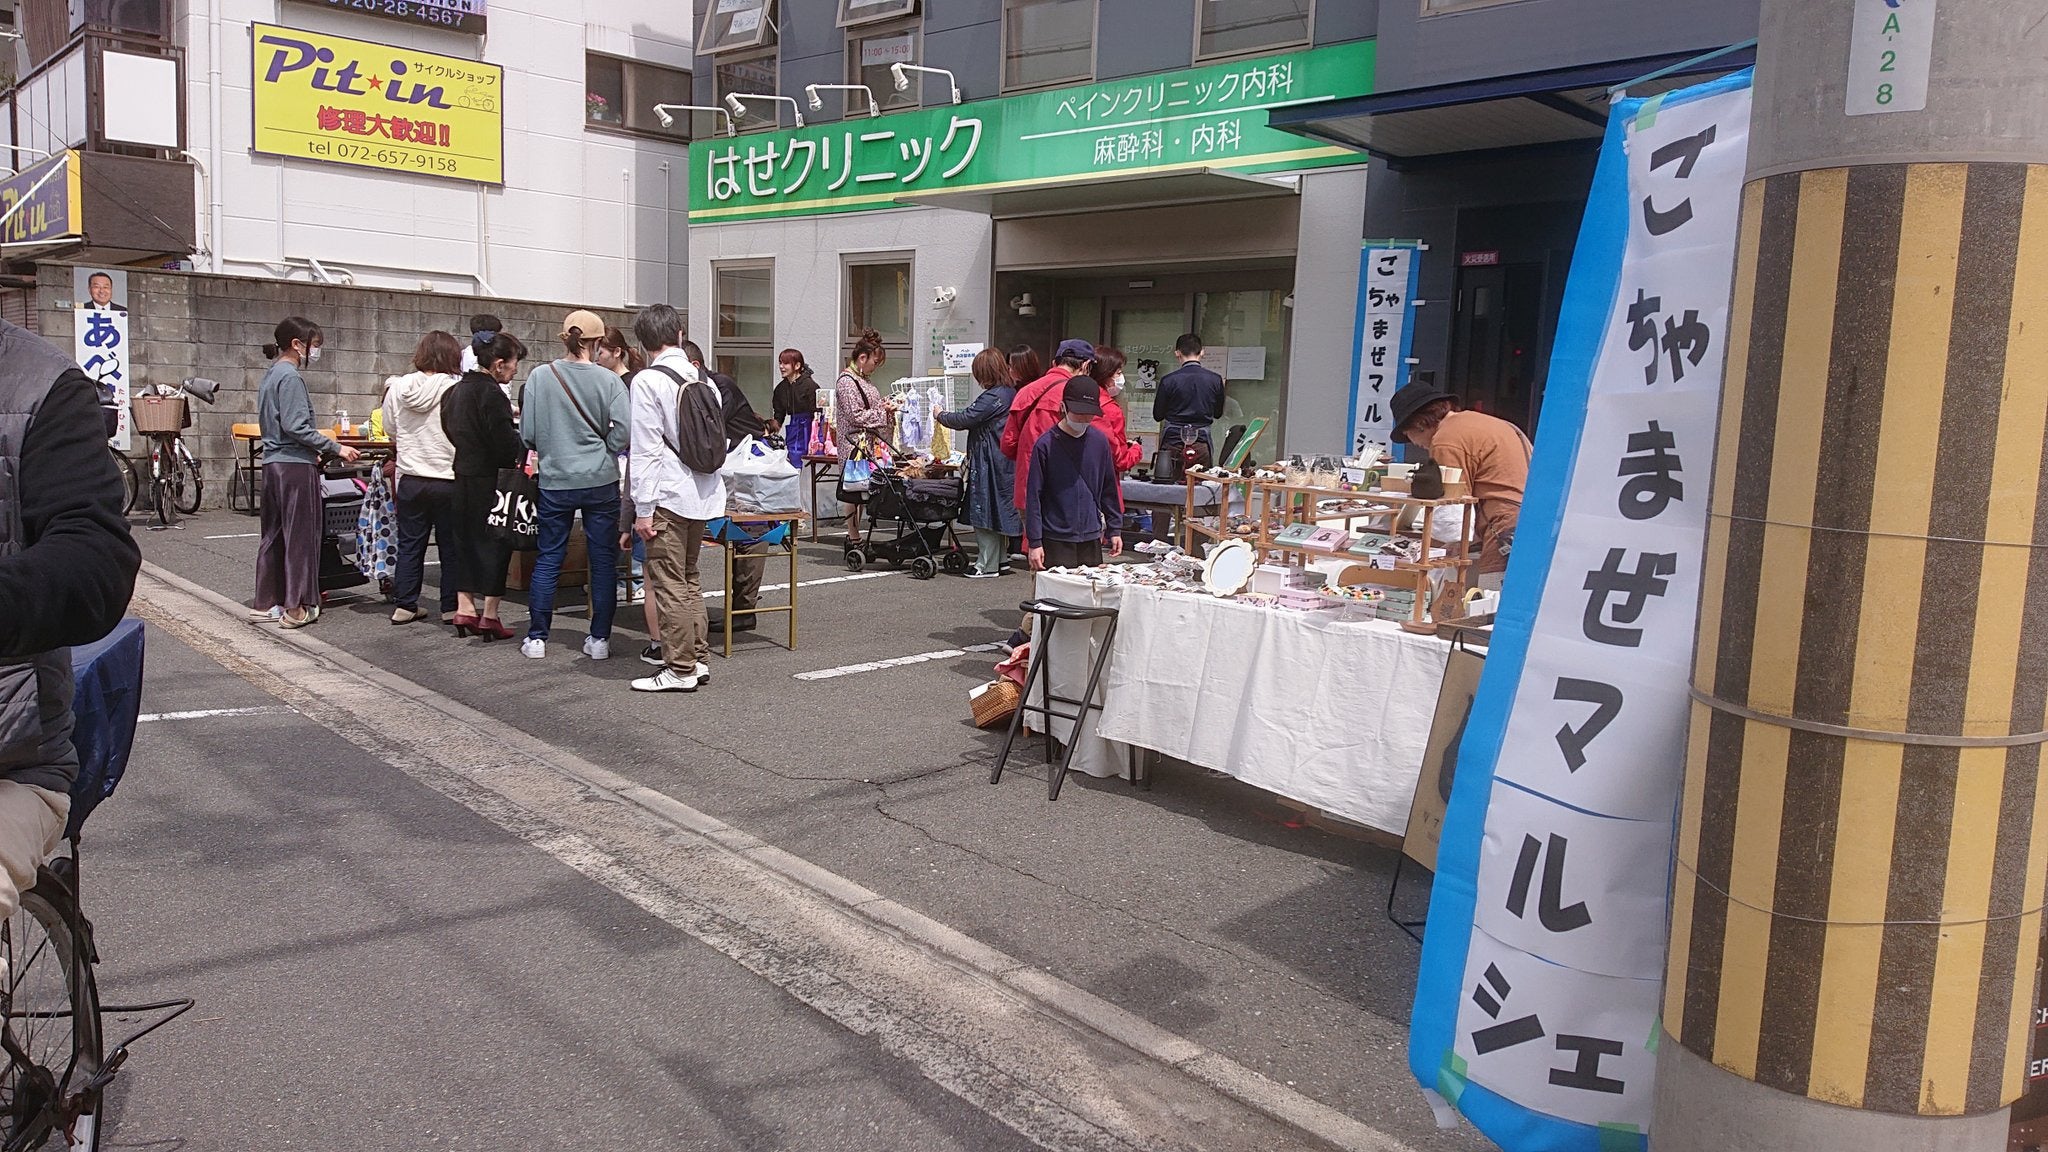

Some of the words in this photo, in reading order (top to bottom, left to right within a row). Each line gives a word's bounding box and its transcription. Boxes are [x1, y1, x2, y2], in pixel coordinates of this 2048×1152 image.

[413, 62, 497, 86] サイクルショップ
[1056, 61, 1294, 120] ペインクリニック内科
[308, 140, 331, 156] tel
[337, 143, 458, 173] 072-657-9158
[707, 115, 983, 200] はせクリニック
[1094, 118, 1242, 166] 麻酔科・内科
[1471, 123, 1717, 1096] ごちゃまぜマルシェ
